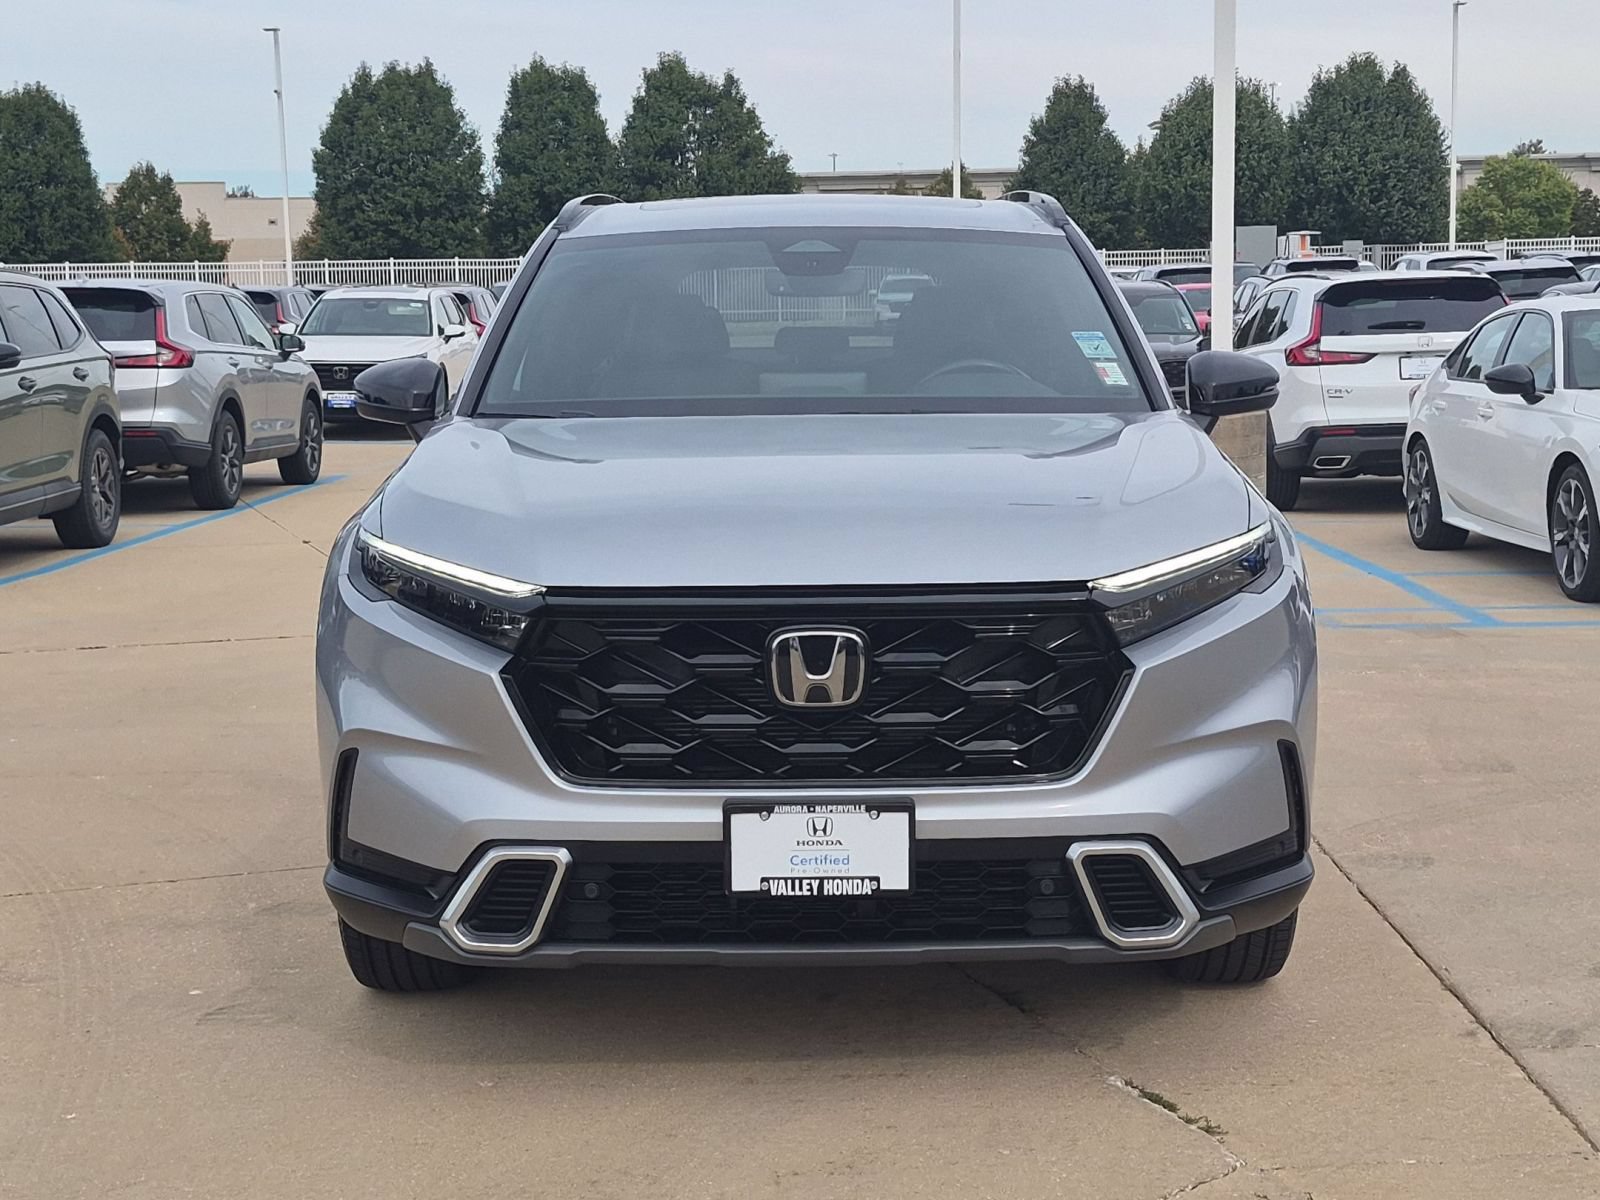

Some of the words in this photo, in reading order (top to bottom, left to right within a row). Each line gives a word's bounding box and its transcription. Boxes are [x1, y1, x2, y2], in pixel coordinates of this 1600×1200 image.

[773, 805, 808, 814] AURORA
[815, 804, 866, 813] NAPERVILLE
[796, 839, 843, 847] HONDA
[790, 854, 850, 866] Certified
[769, 879, 820, 896] VALLEY
[823, 878, 872, 895] HONDA
